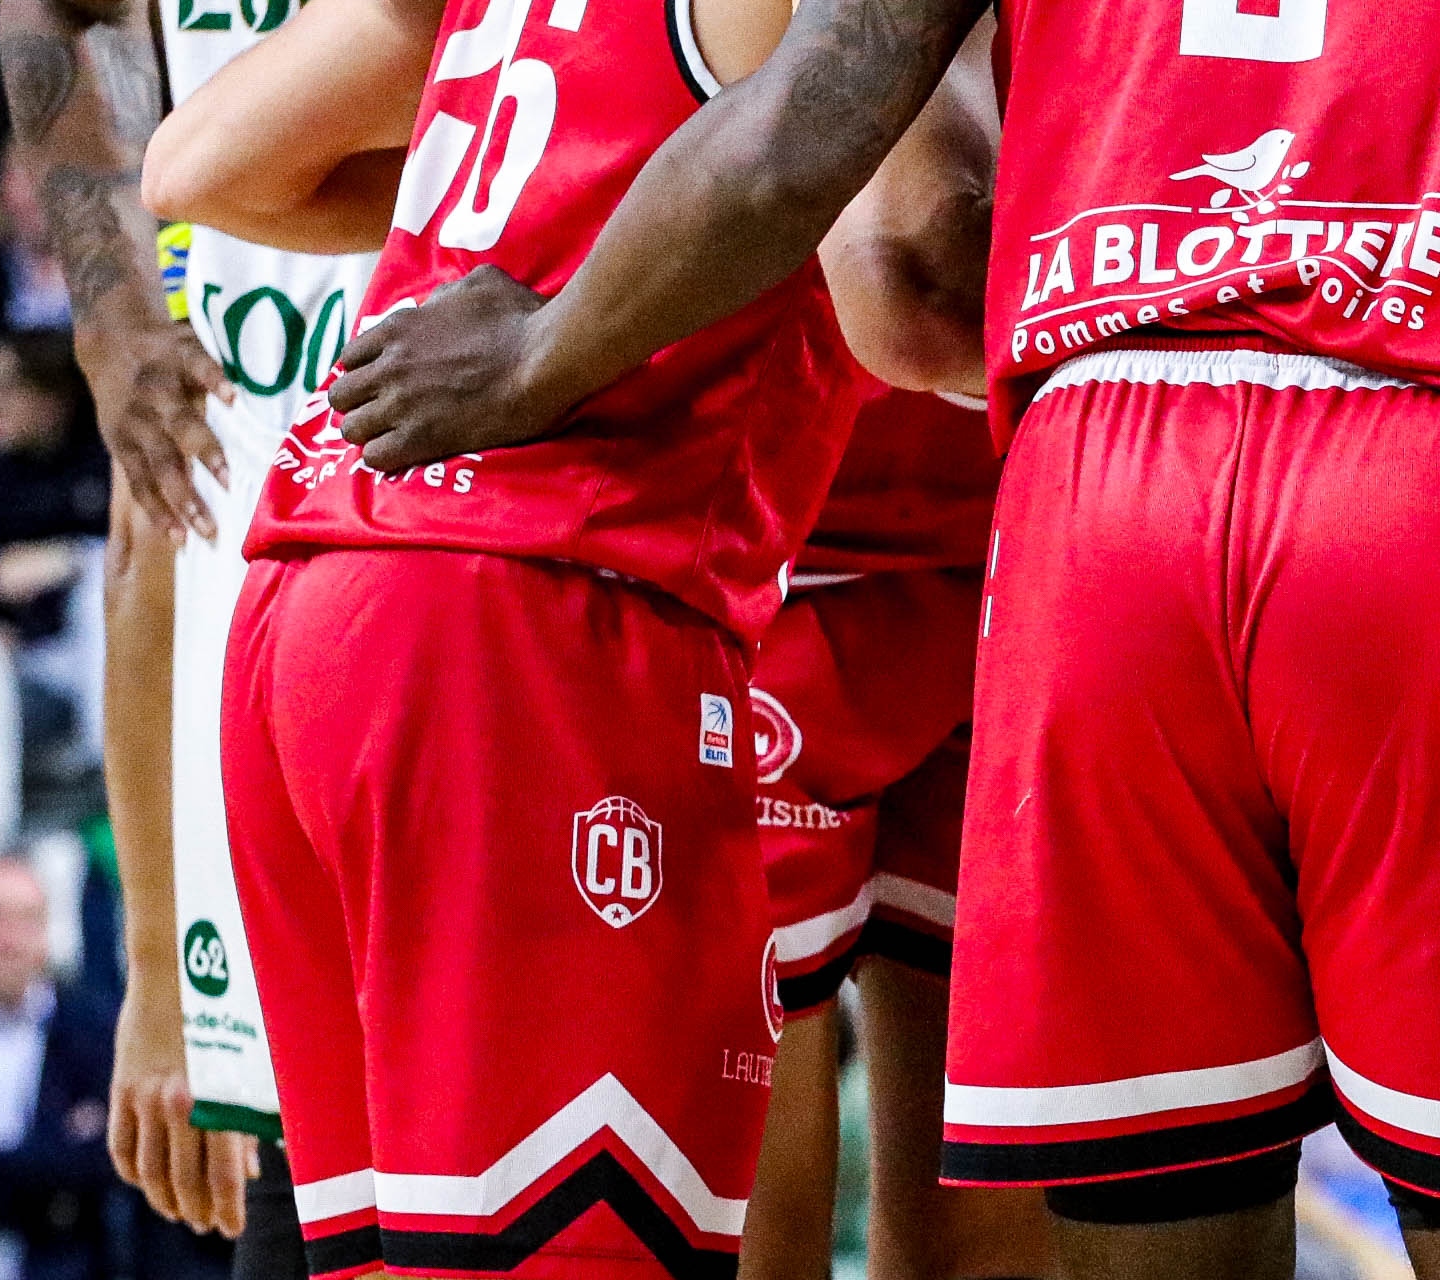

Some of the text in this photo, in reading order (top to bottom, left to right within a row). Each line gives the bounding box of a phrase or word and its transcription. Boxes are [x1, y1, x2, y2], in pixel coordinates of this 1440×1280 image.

[1020, 238, 1076, 312] LA
[1011, 294, 1191, 363] Pommes
[1216, 273, 1265, 304] et
[586, 823, 652, 899] CB
[187, 934, 228, 980] 62
